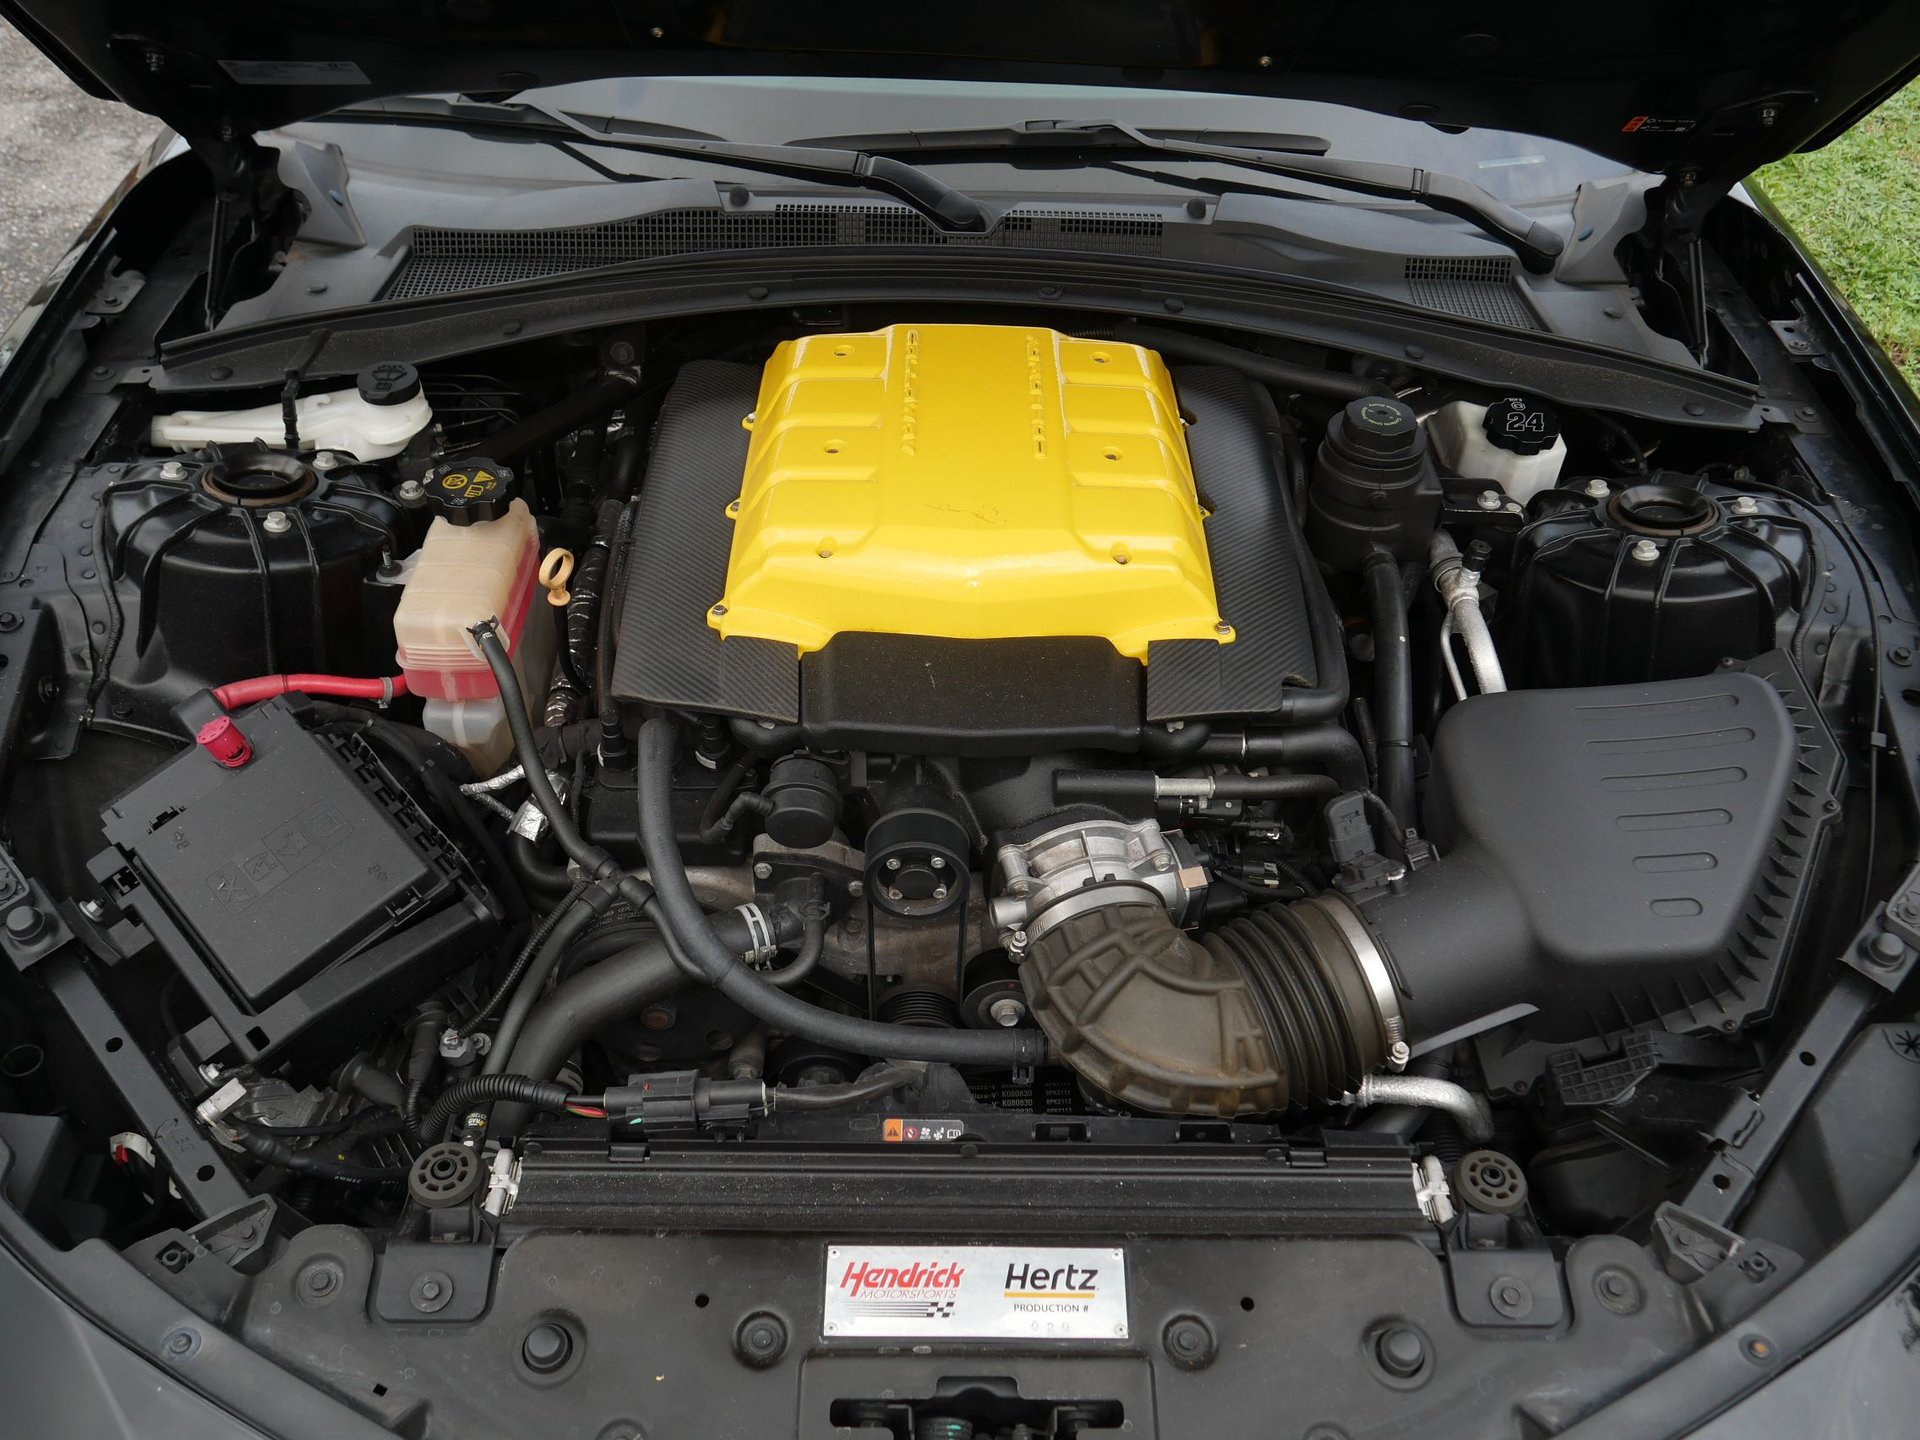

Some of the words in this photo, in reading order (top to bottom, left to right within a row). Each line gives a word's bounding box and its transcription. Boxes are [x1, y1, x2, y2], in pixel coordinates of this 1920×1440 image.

[1506, 412, 1545, 432] 24
[840, 1262, 965, 1298] Hendrick
[1004, 1263, 1098, 1291] Hertz
[860, 1288, 957, 1299] MOTORSPORTS
[1013, 1303, 1079, 1313] PRODUCTION
